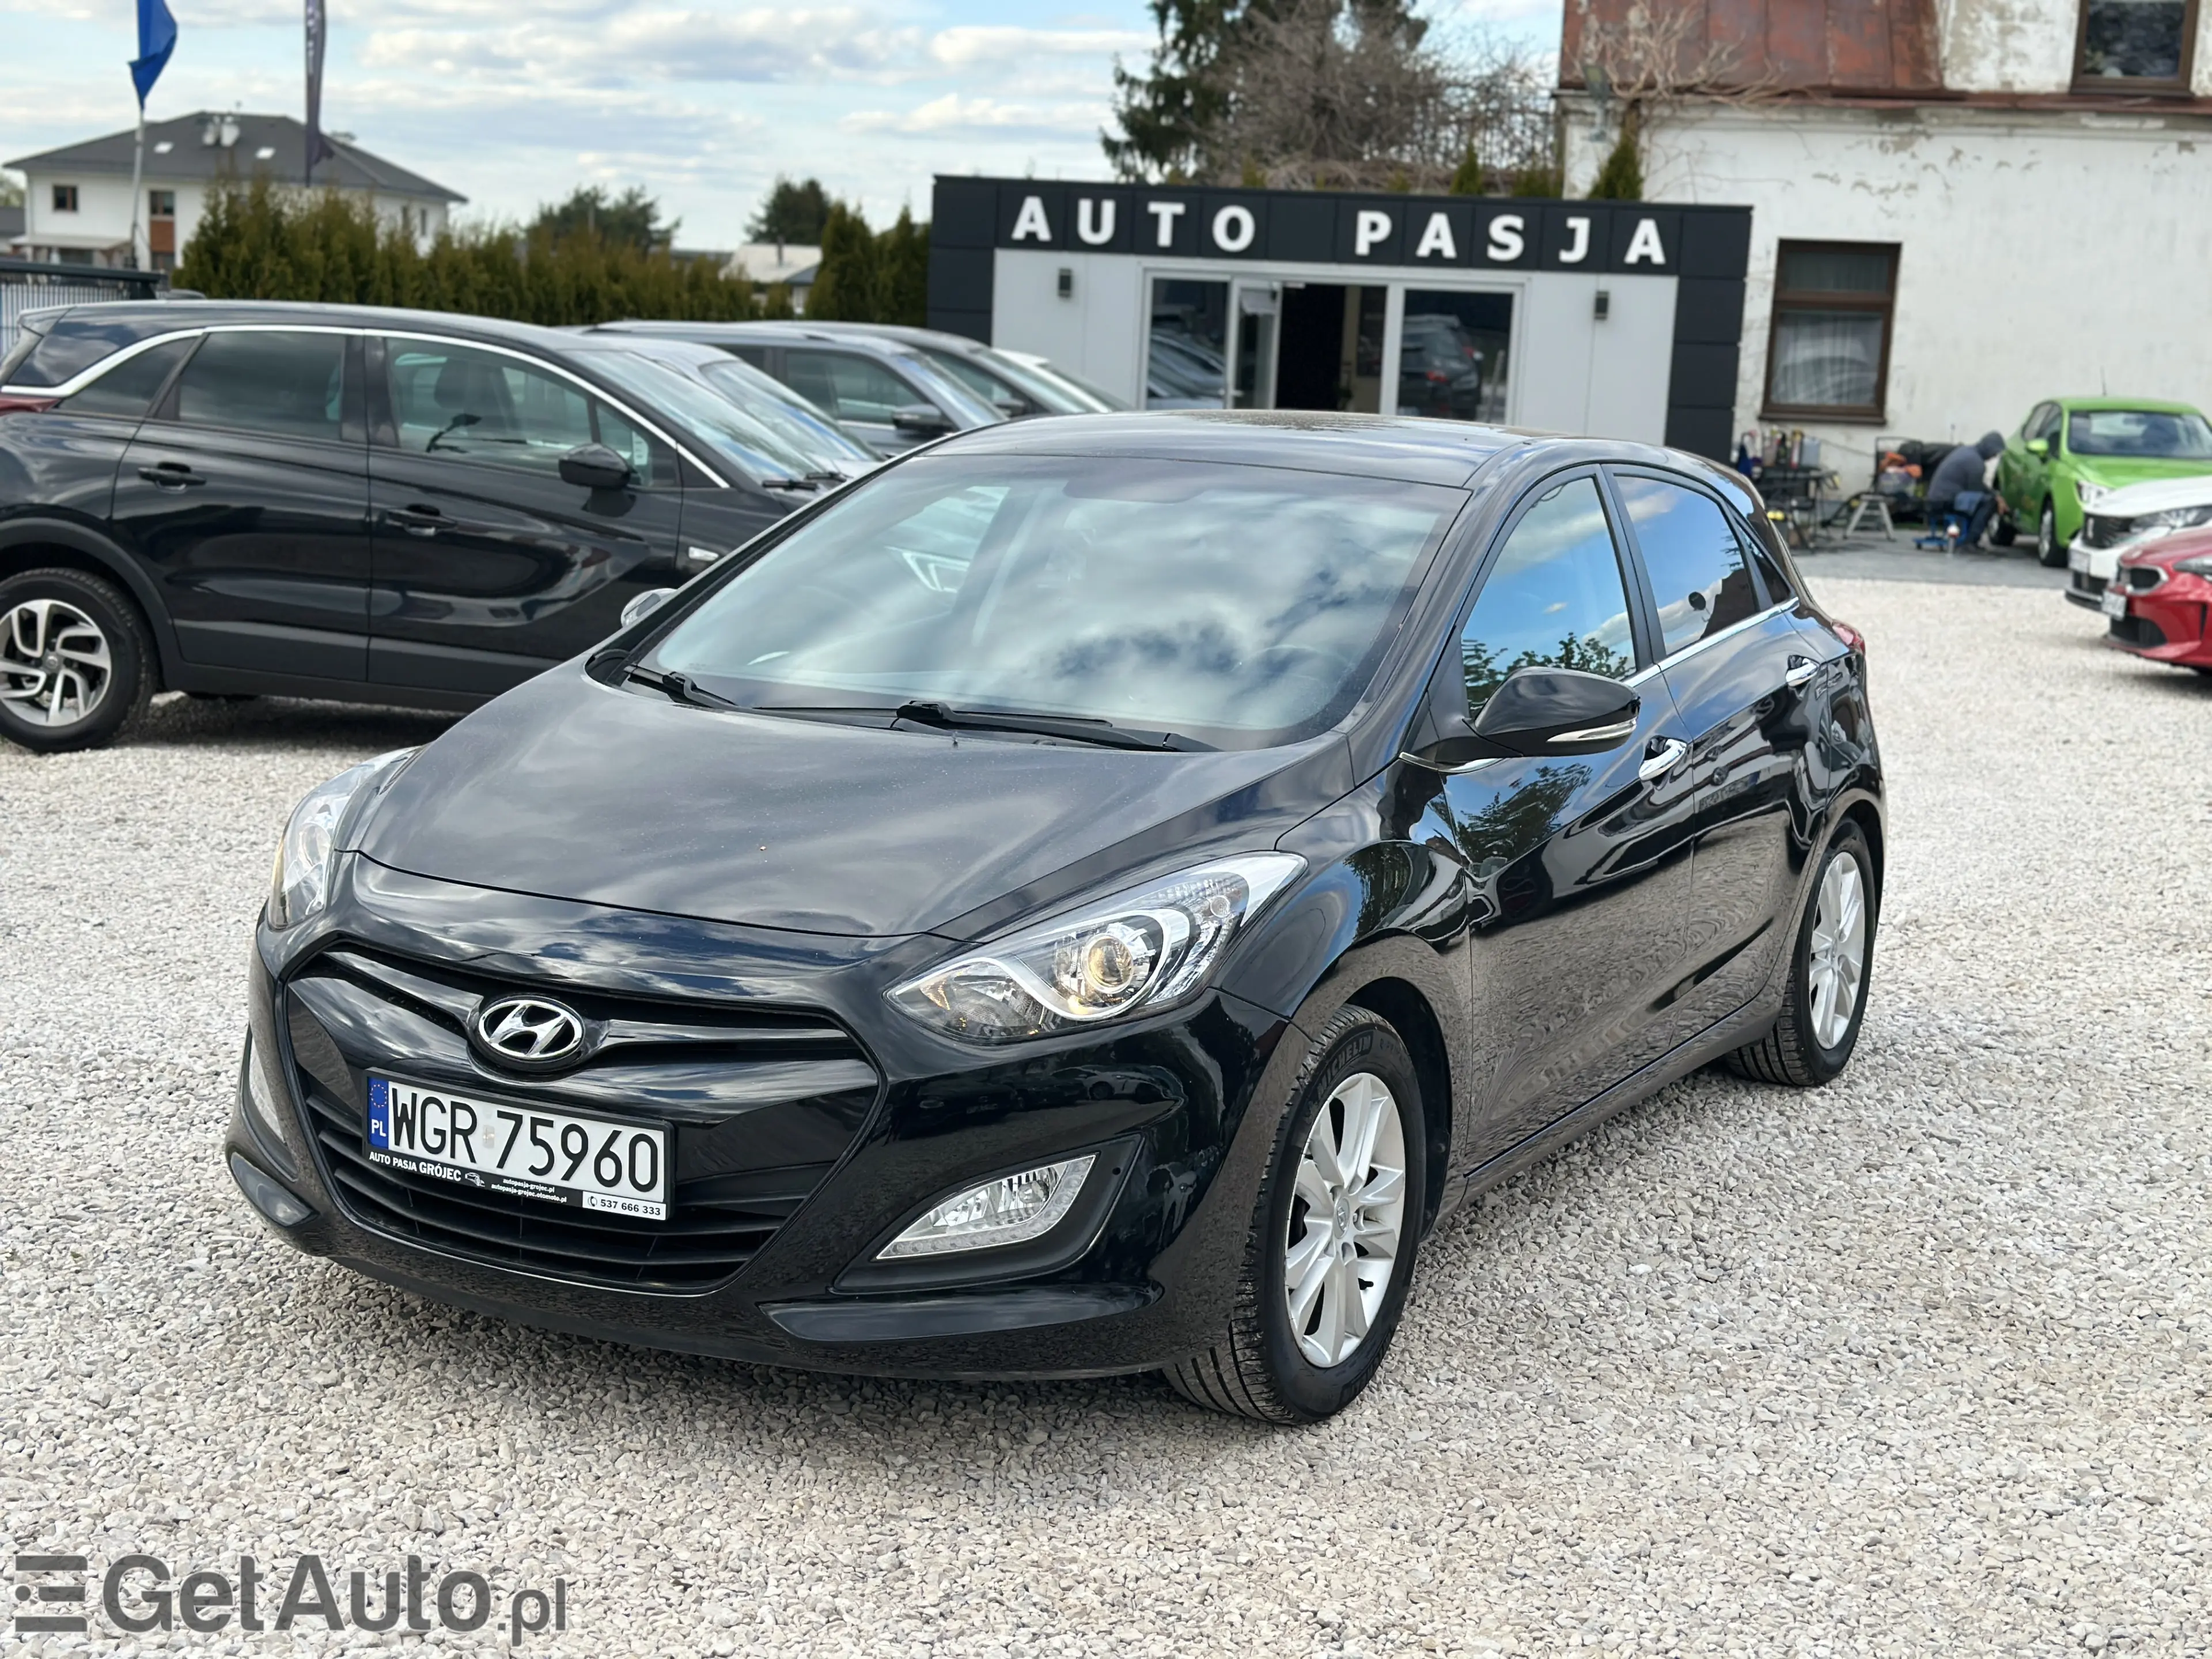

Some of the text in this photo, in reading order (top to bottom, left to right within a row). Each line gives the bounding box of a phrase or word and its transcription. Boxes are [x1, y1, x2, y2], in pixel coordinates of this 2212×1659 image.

[1011, 195, 1666, 264] AUTO PASJA
[1317, 1035, 1372, 1100] MICHELIN
[371, 1119, 387, 1138] PL
[392, 1087, 658, 1193] WGR 75960
[369, 1152, 461, 1181] AUTO PASJA GRÓJEC
[491, 1183, 567, 1203] autopasja-grojec.otomoto.pl
[503, 1178, 555, 1194] autopasja-grojec.pl
[600, 1199, 661, 1215] 537 666 333
